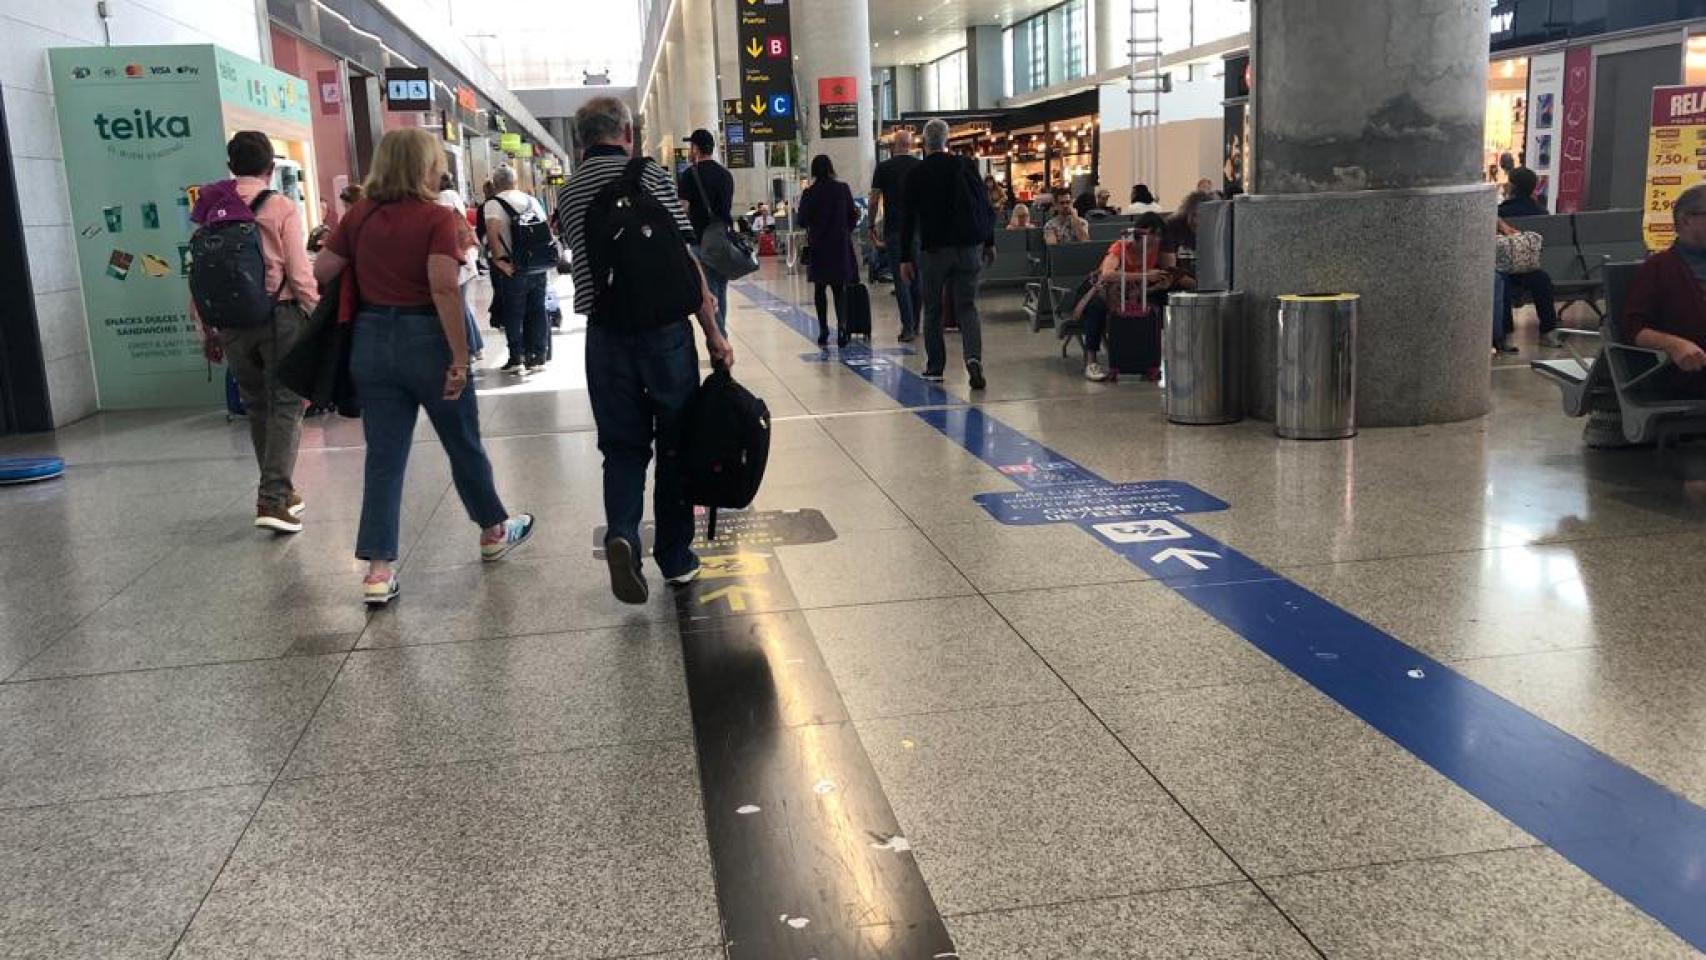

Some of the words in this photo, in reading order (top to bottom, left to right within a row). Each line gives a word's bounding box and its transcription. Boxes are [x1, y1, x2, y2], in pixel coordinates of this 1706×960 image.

[770, 39, 782, 54] B
[150, 66, 171, 75] VISA
[774, 97, 786, 113] C
[94, 109, 191, 140] teika
[117, 325, 177, 336] SANDWICHES
